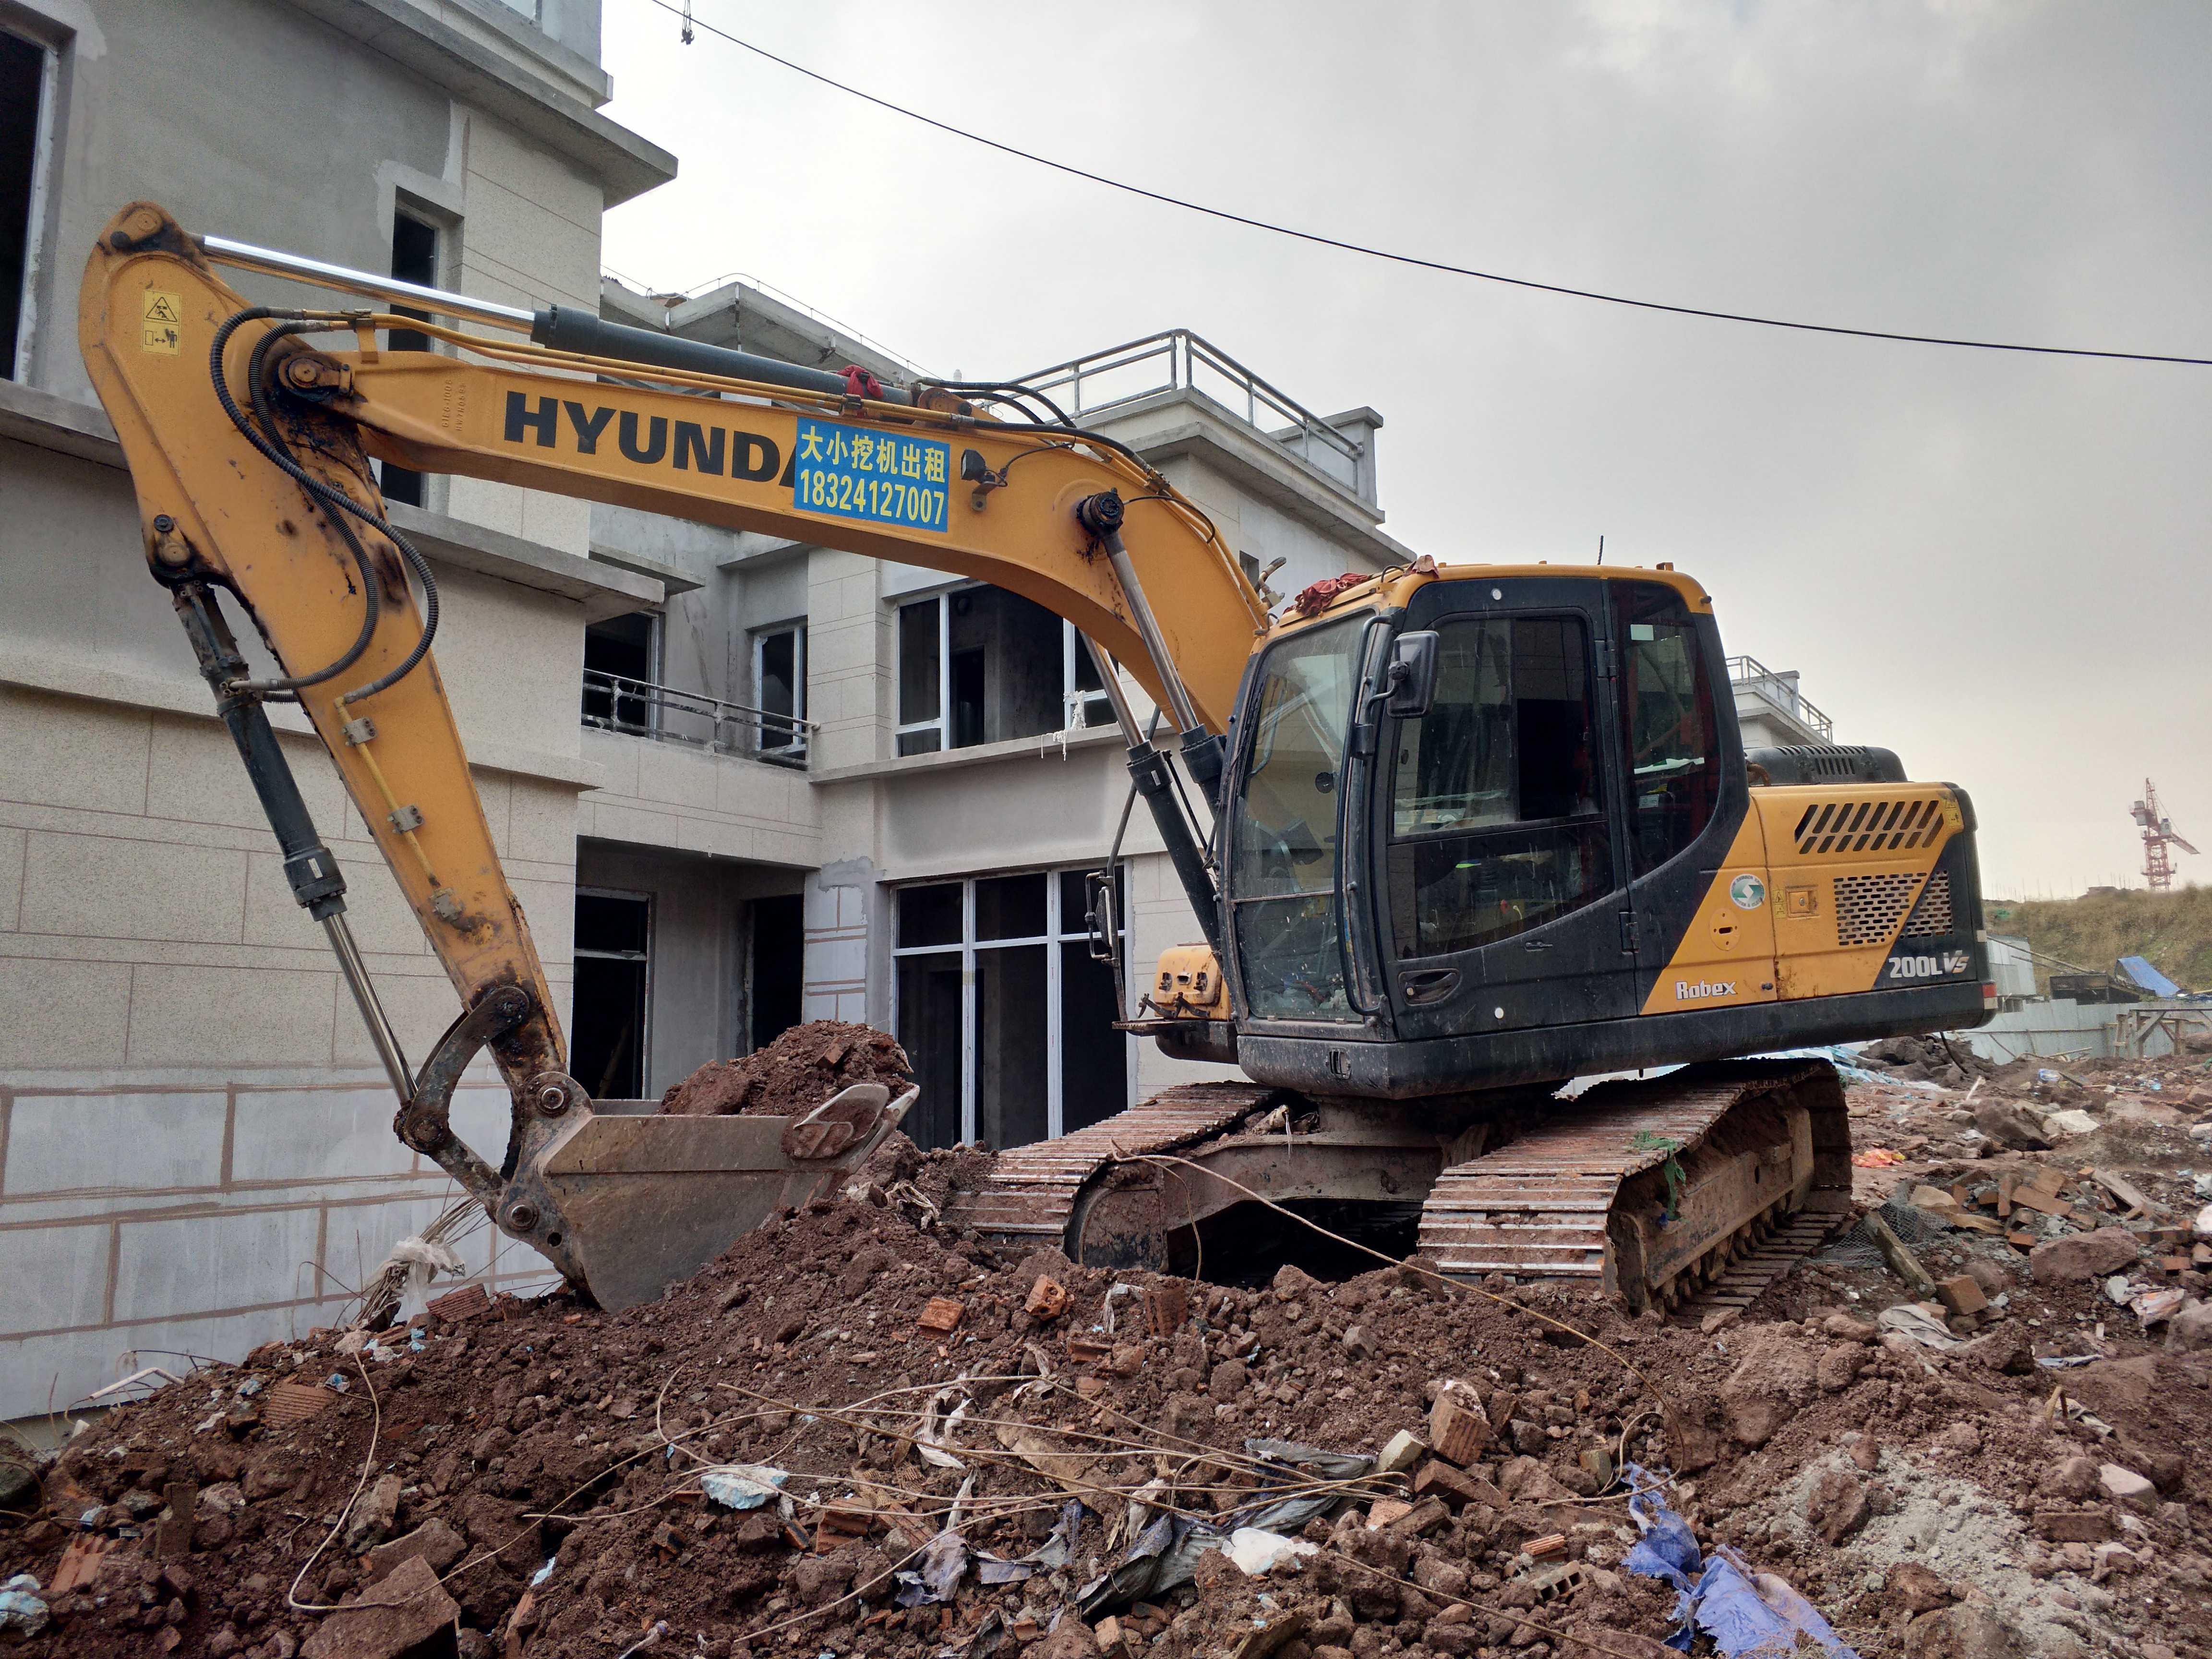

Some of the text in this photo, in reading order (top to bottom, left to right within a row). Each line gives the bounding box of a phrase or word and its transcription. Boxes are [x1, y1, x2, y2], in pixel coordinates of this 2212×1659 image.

[801, 425, 945, 483] 大小挖机出租
[800, 469, 945, 525] 18324127007
[1675, 979, 1738, 1000] Robex
